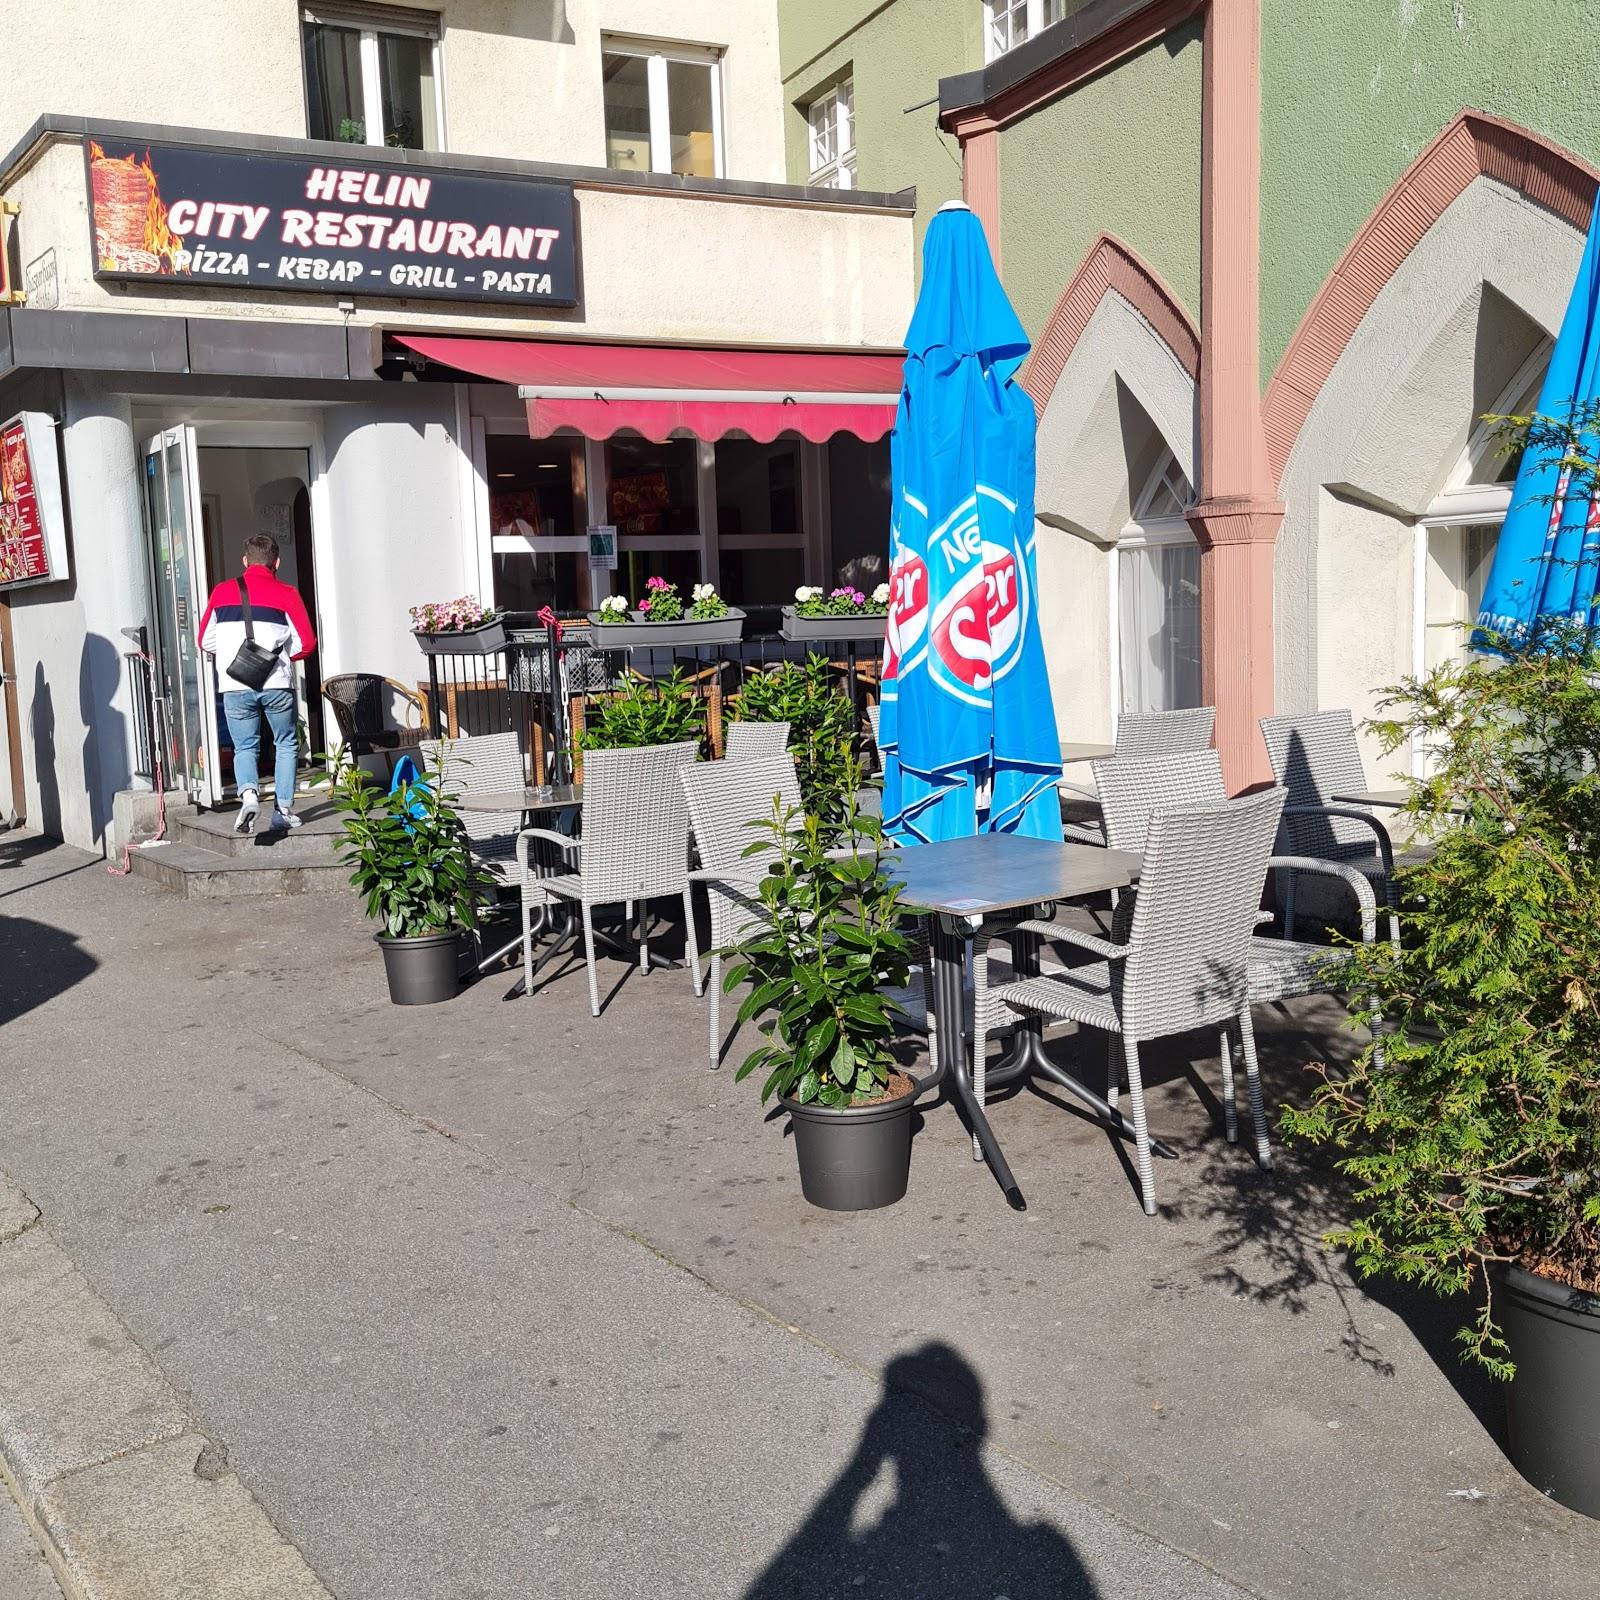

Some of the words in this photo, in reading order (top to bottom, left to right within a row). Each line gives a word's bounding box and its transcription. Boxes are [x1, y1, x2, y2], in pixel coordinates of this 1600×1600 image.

[306, 168, 432, 209] HELIN
[168, 200, 270, 241] CITY
[282, 209, 560, 261] RESTAURANT
[278, 256, 364, 282] KEBAP
[390, 263, 458, 289] GRILL
[482, 270, 552, 294] PASTA
